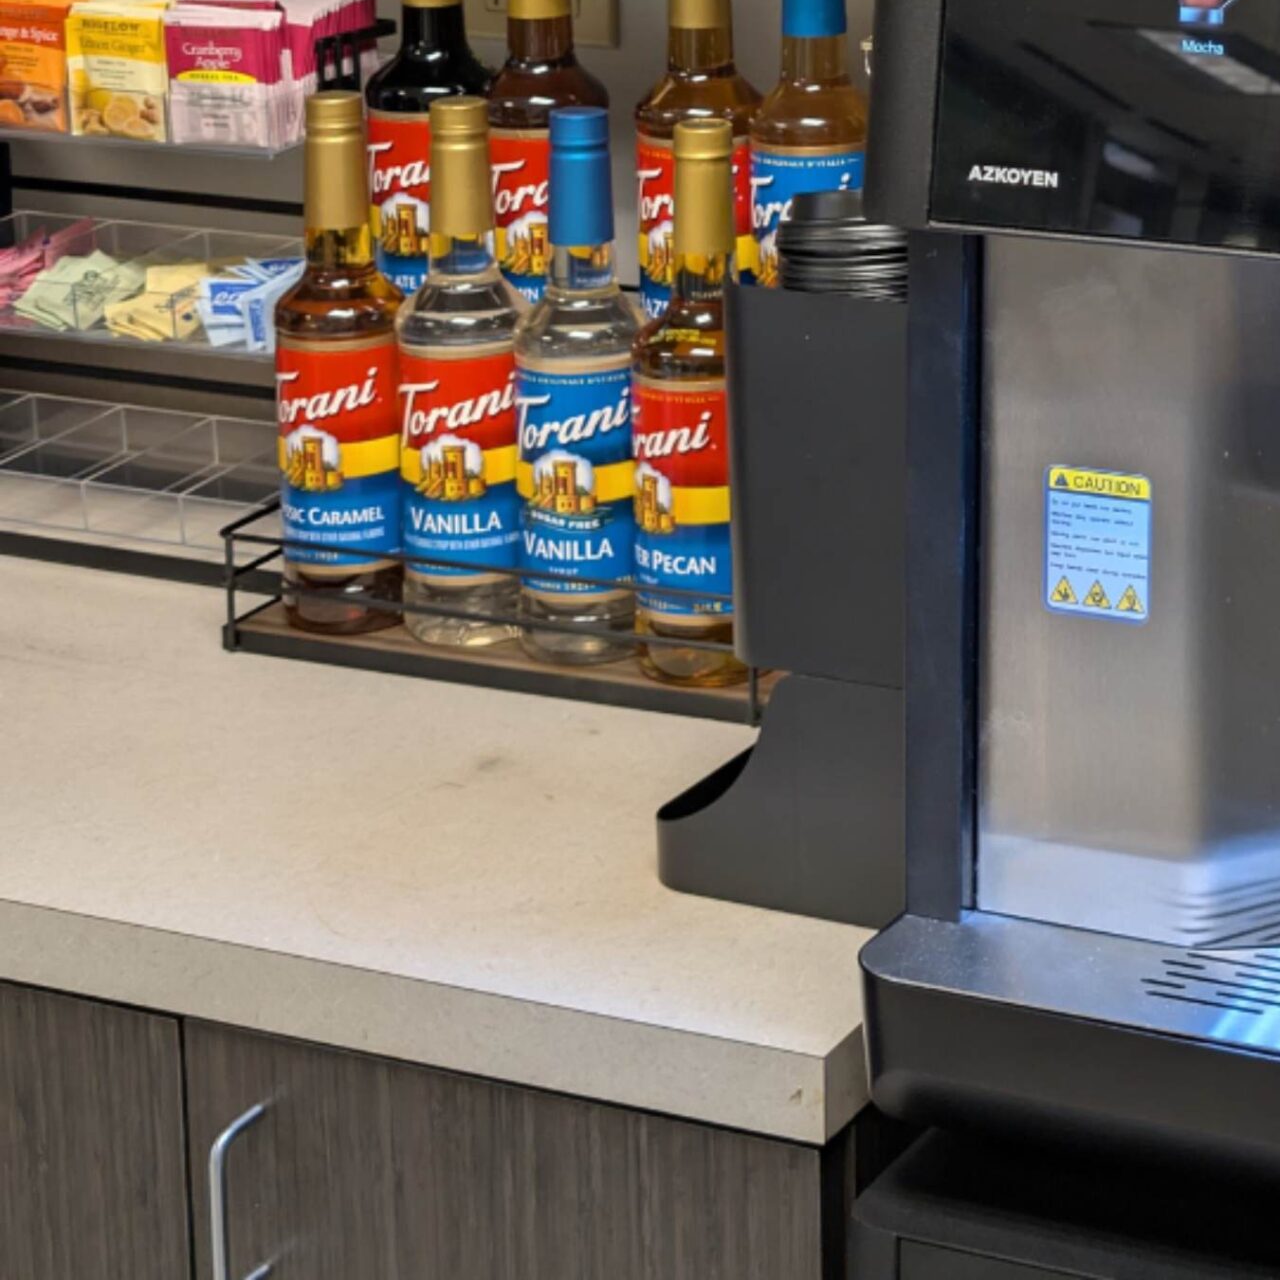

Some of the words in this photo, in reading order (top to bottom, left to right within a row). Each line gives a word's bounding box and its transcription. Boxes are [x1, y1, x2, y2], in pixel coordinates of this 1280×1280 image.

[181, 40, 243, 62] Cranberry
[1181, 38, 1225, 56] Mocha
[967, 164, 1060, 189] AZKOYEN
[398, 372, 516, 447] Torani
[514, 387, 630, 460] Torani
[633, 411, 710, 459] rani
[1072, 475, 1142, 497] CAUTION
[307, 504, 385, 526] CARAMEL
[410, 506, 503, 535] VANILLA
[523, 530, 615, 561] VANILLA
[651, 549, 717, 576] PECAN
